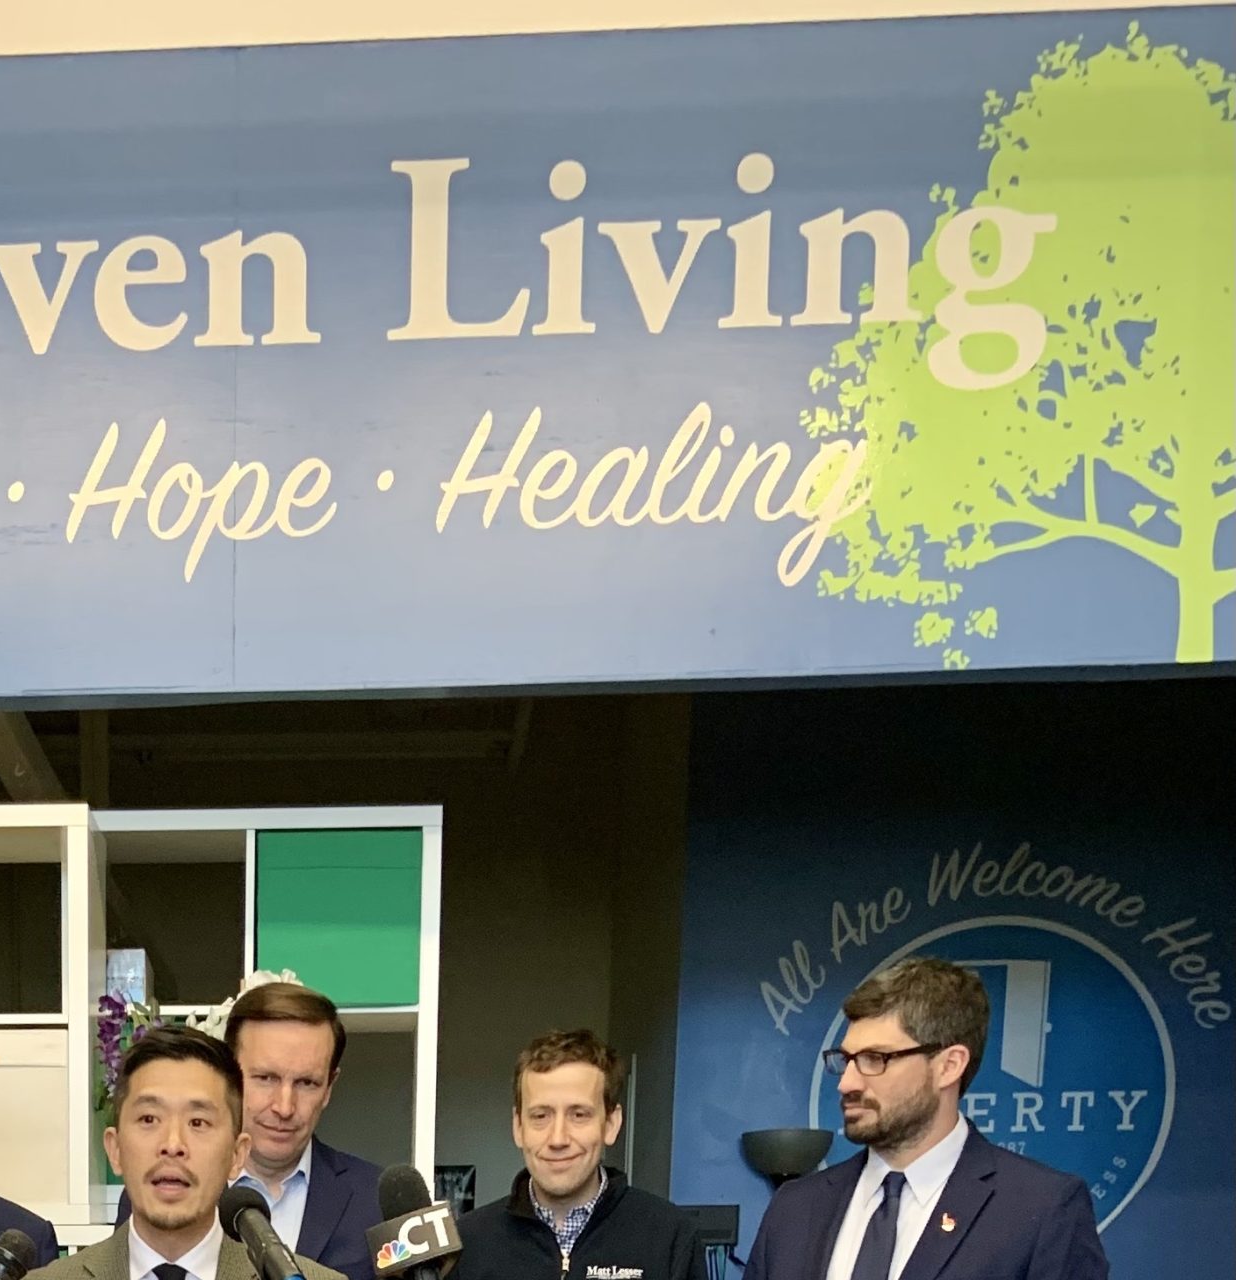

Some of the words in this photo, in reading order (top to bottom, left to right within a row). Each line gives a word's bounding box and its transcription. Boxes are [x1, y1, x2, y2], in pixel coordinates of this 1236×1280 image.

[387, 152, 1056, 390] Living
[66, 418, 336, 582] Hope
[437, 401, 876, 588] Healing
[760, 940, 825, 1036] All
[830, 886, 911, 962] Are
[927, 841, 1147, 927] Welcome
[1142, 917, 1231, 1029] Here
[398, 1207, 449, 1255] CT
[586, 1265, 611, 1276] Matt
[612, 1265, 644, 1277] Lesser
